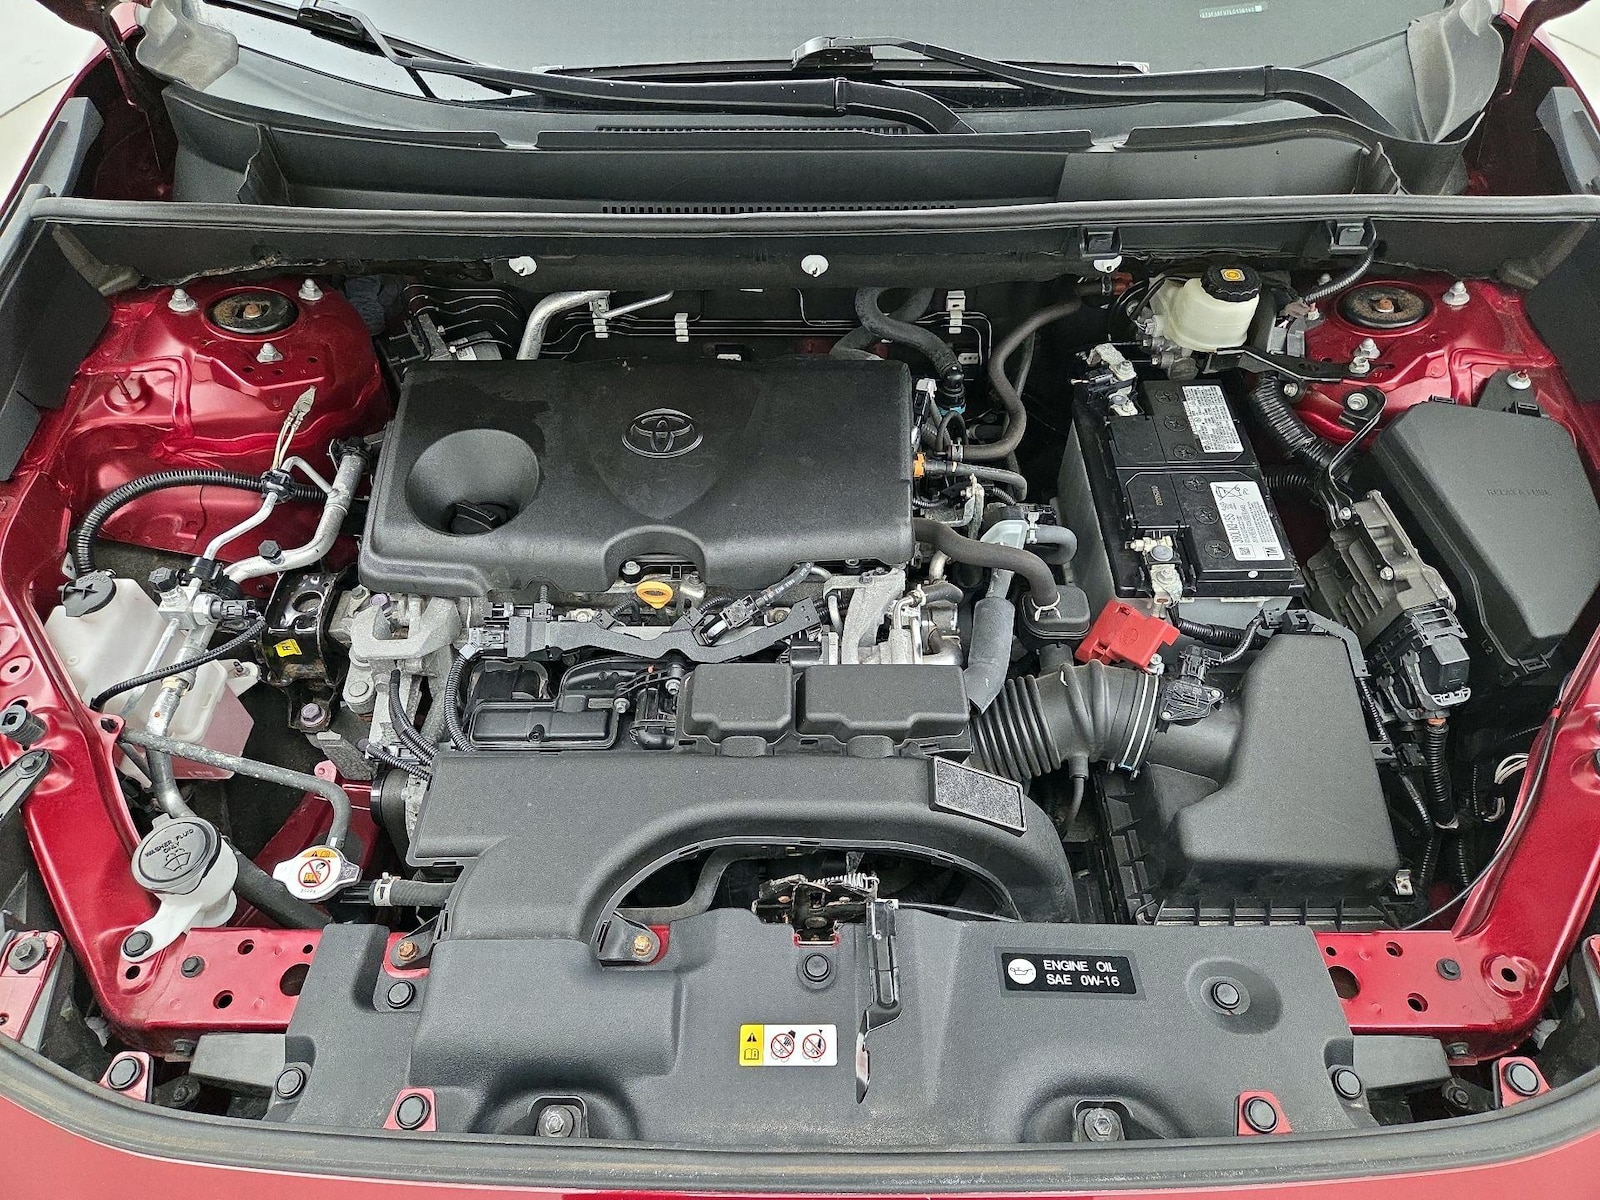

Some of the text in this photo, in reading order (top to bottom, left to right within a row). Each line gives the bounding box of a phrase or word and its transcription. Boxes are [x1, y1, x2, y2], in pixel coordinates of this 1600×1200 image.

[144, 839, 172, 857] WASHER
[1043, 959, 1118, 973] ENGINE OIL
[1045, 973, 1121, 987] SAE 0W-16
